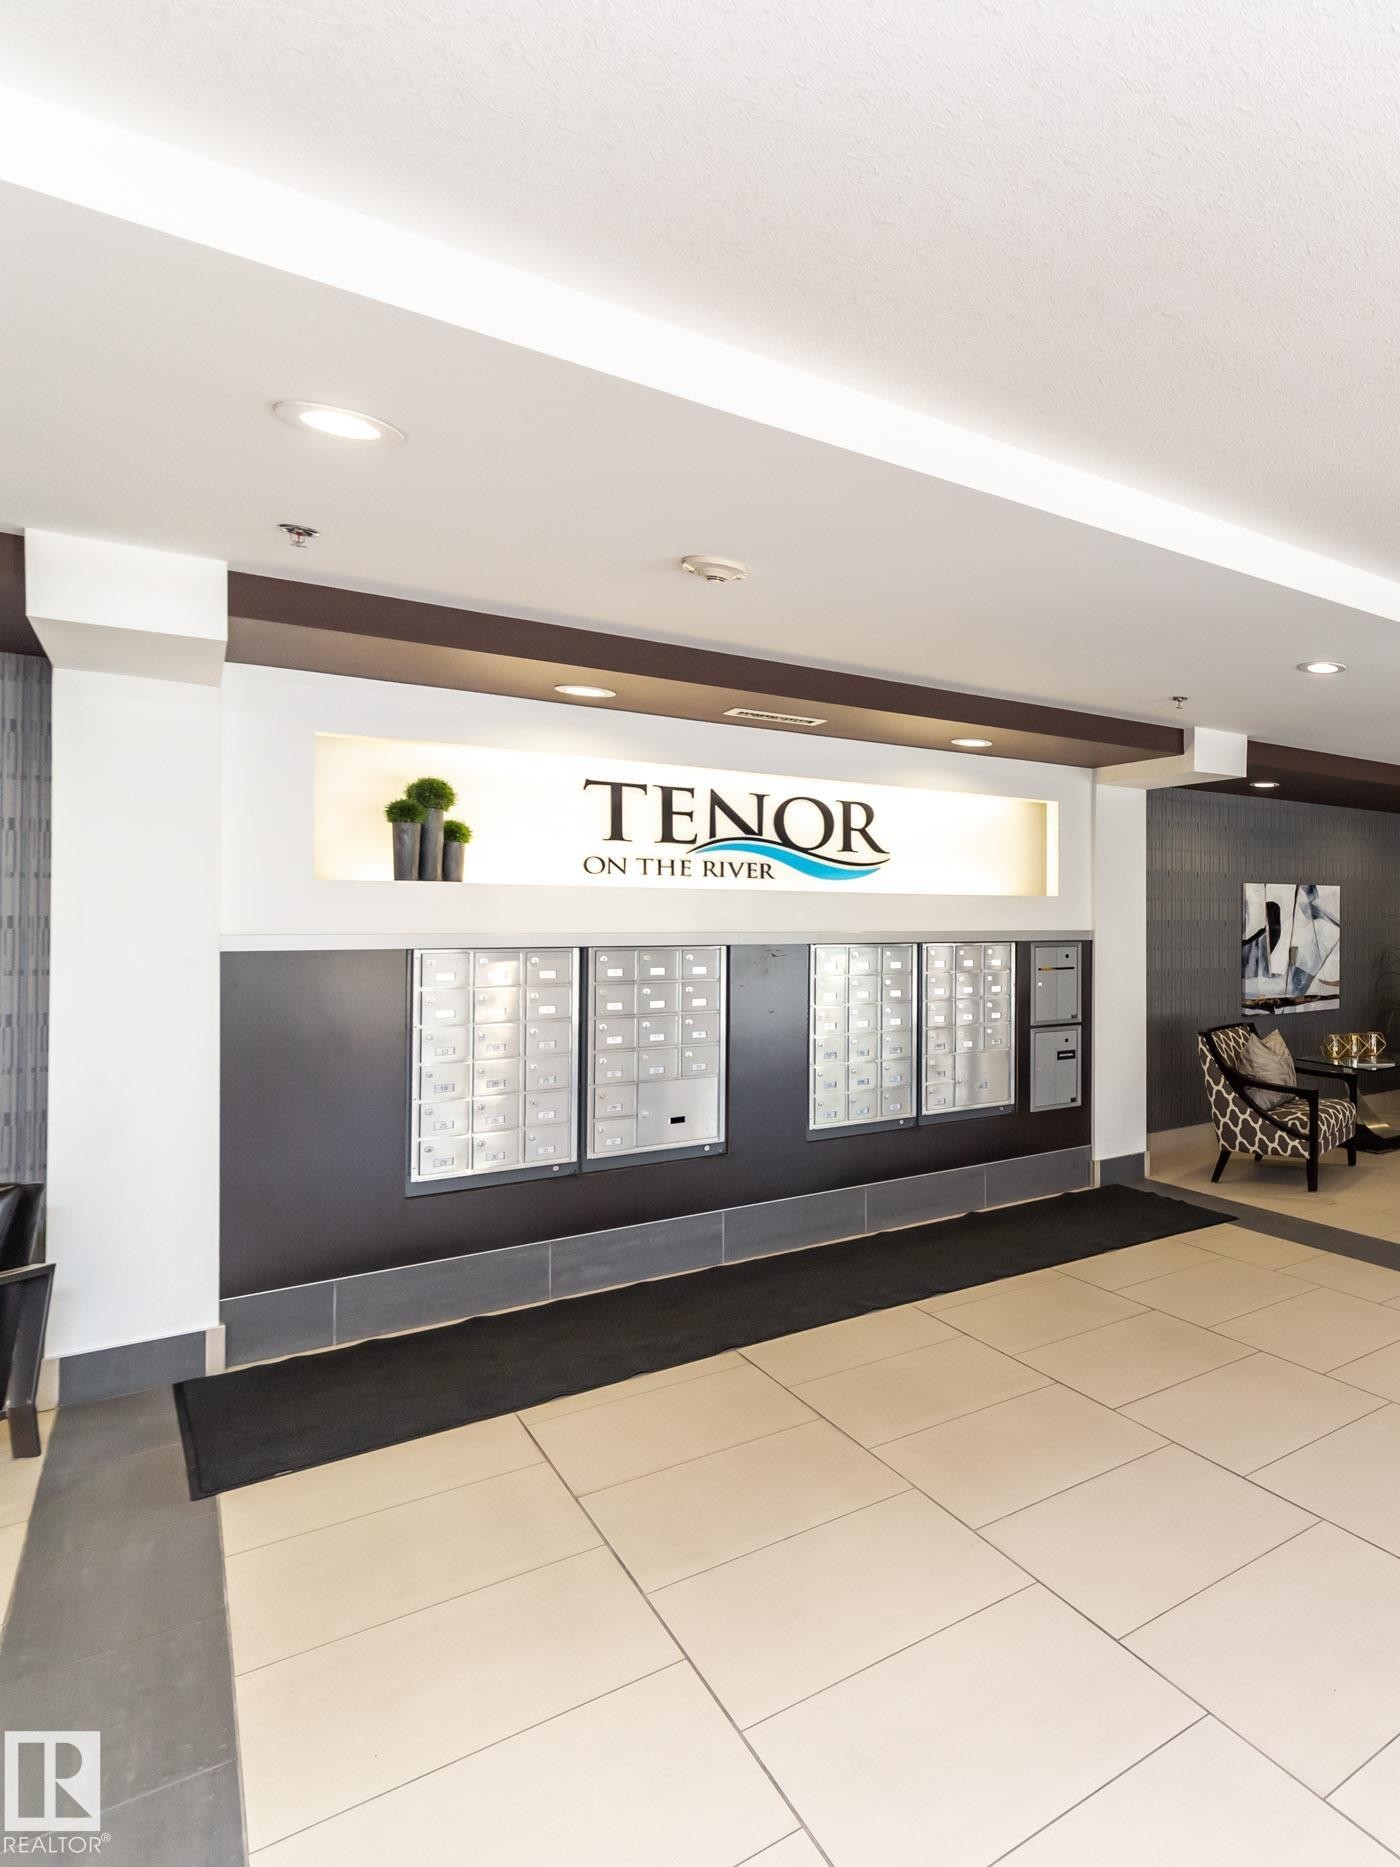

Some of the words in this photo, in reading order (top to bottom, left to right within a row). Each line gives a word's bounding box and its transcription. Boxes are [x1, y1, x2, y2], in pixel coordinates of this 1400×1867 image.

[583, 778, 890, 854] TENOR
[583, 856, 627, 875] ON
[636, 857, 692, 878] THE
[703, 860, 776, 880] RIVER
